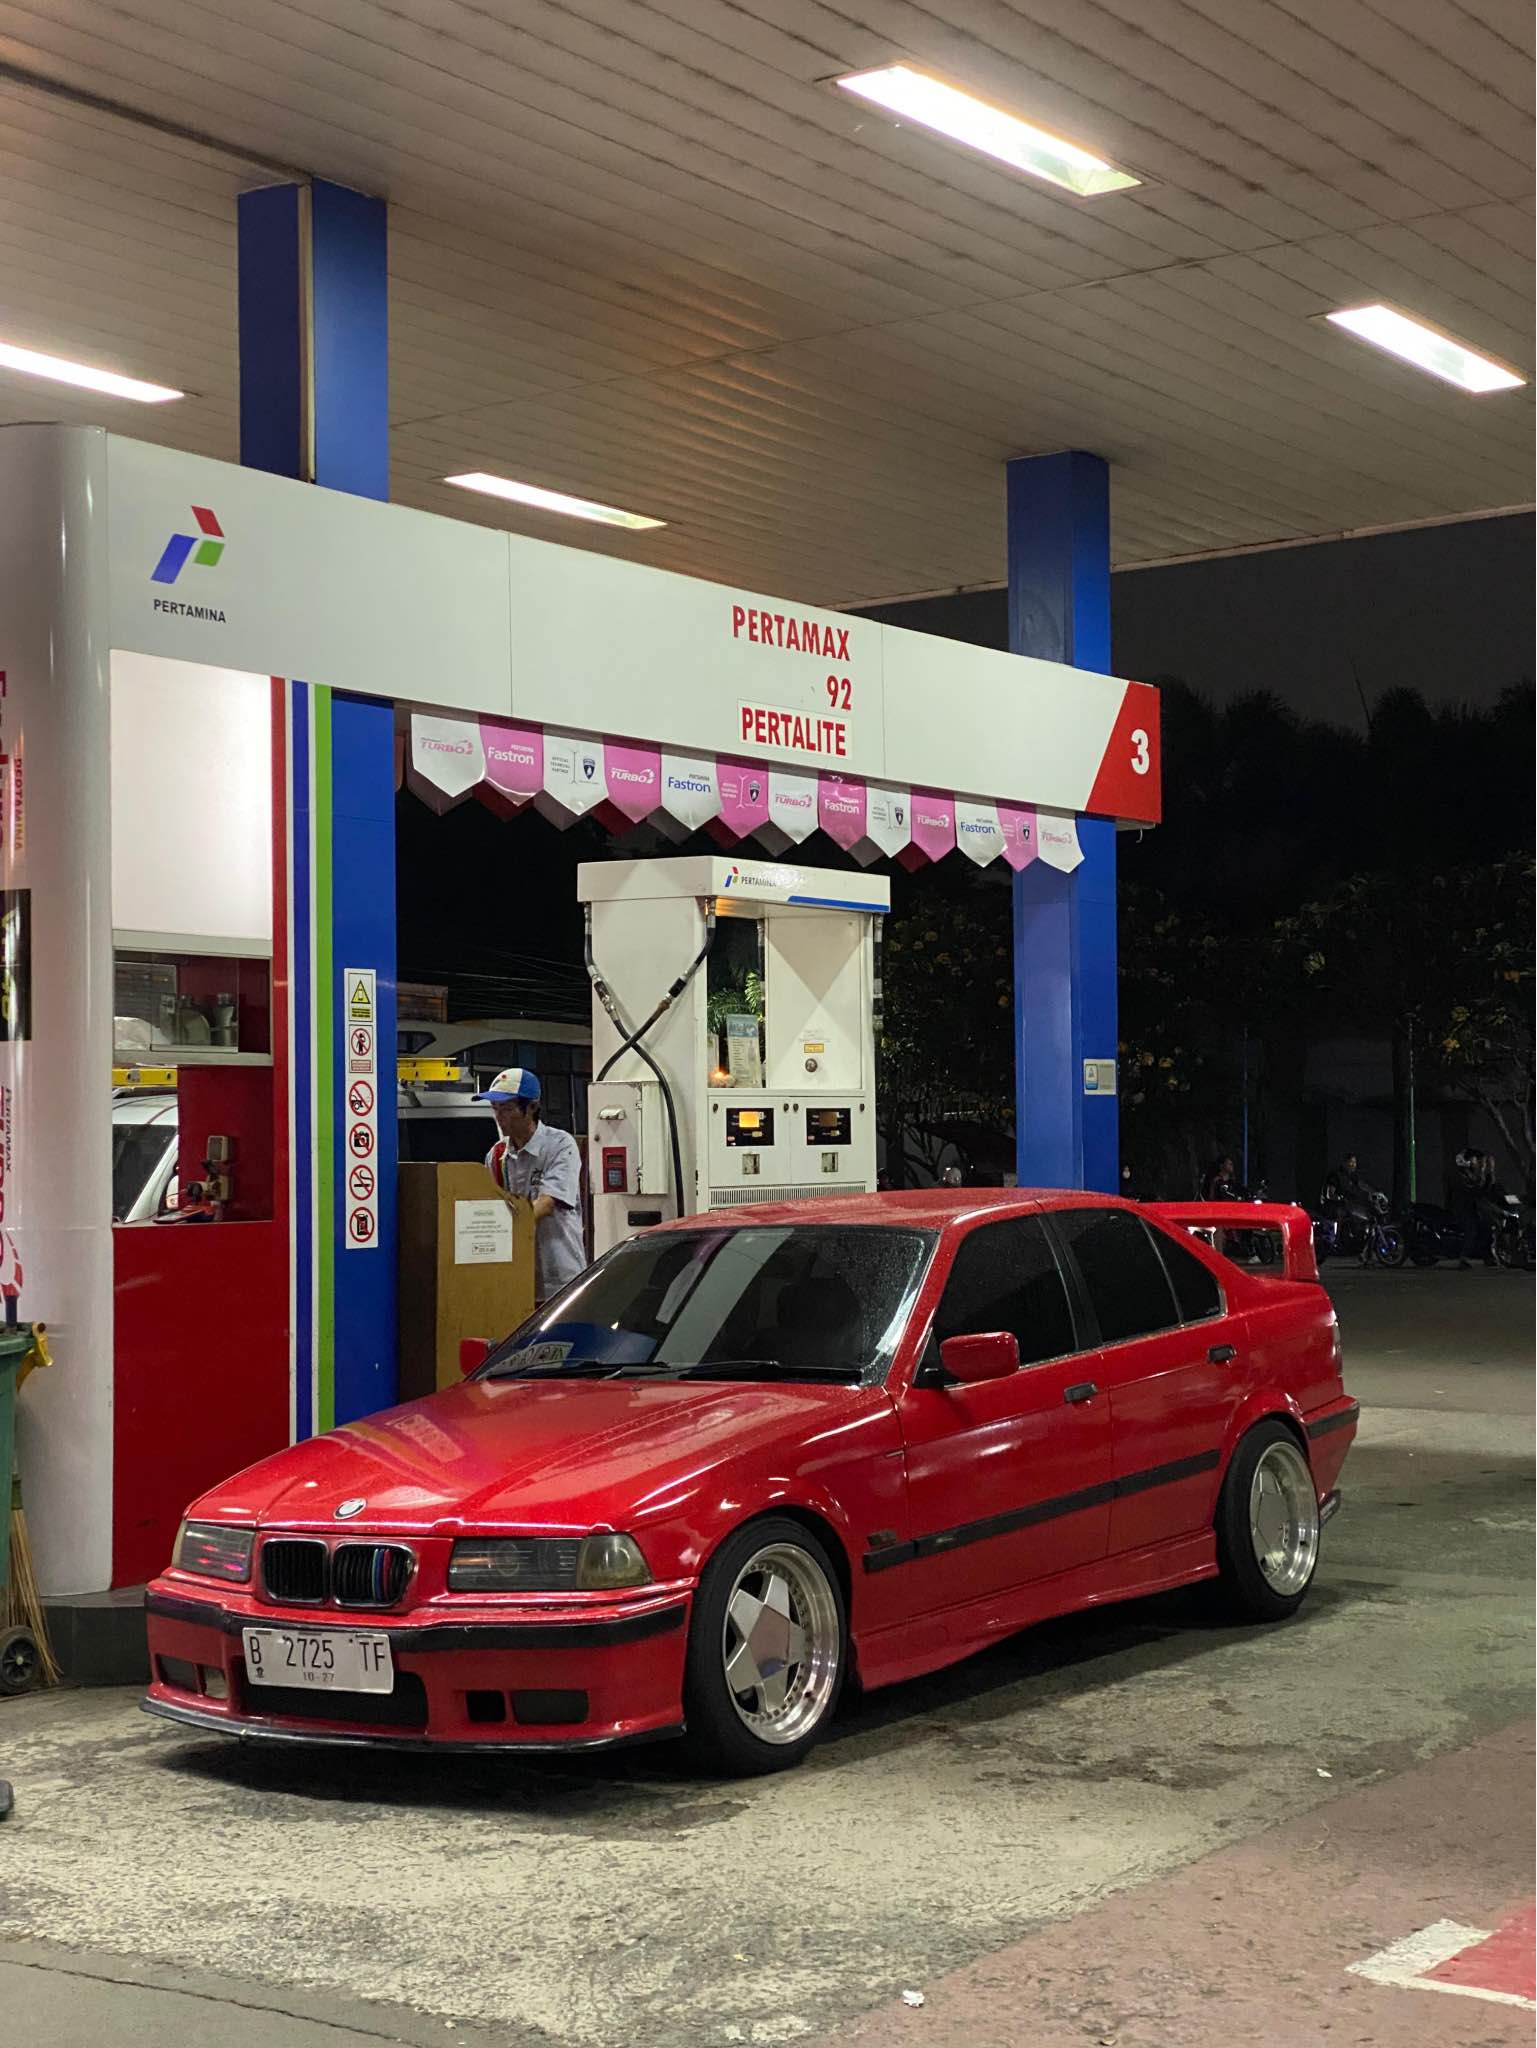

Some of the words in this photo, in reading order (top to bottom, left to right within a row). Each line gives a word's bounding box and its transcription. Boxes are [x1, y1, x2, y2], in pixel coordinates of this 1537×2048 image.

[153, 599, 227, 624] PERTAMINA
[732, 605, 851, 662] PERTAMAX
[826, 675, 852, 711] 92
[741, 707, 847, 756] PERTALITE
[421, 740, 465, 754] TURBO
[487, 746, 535, 766] Fastron
[1130, 728, 1150, 775] 3
[610, 770, 648, 783] TURBO
[668, 776, 711, 793] Fastron
[775, 796, 806, 808] TURBO
[824, 798, 860, 815] Fastron
[960, 821, 996, 834] Fastron
[249, 1636, 262, 1665] B
[286, 1638, 334, 1669] 2725
[359, 1641, 385, 1672] TF
